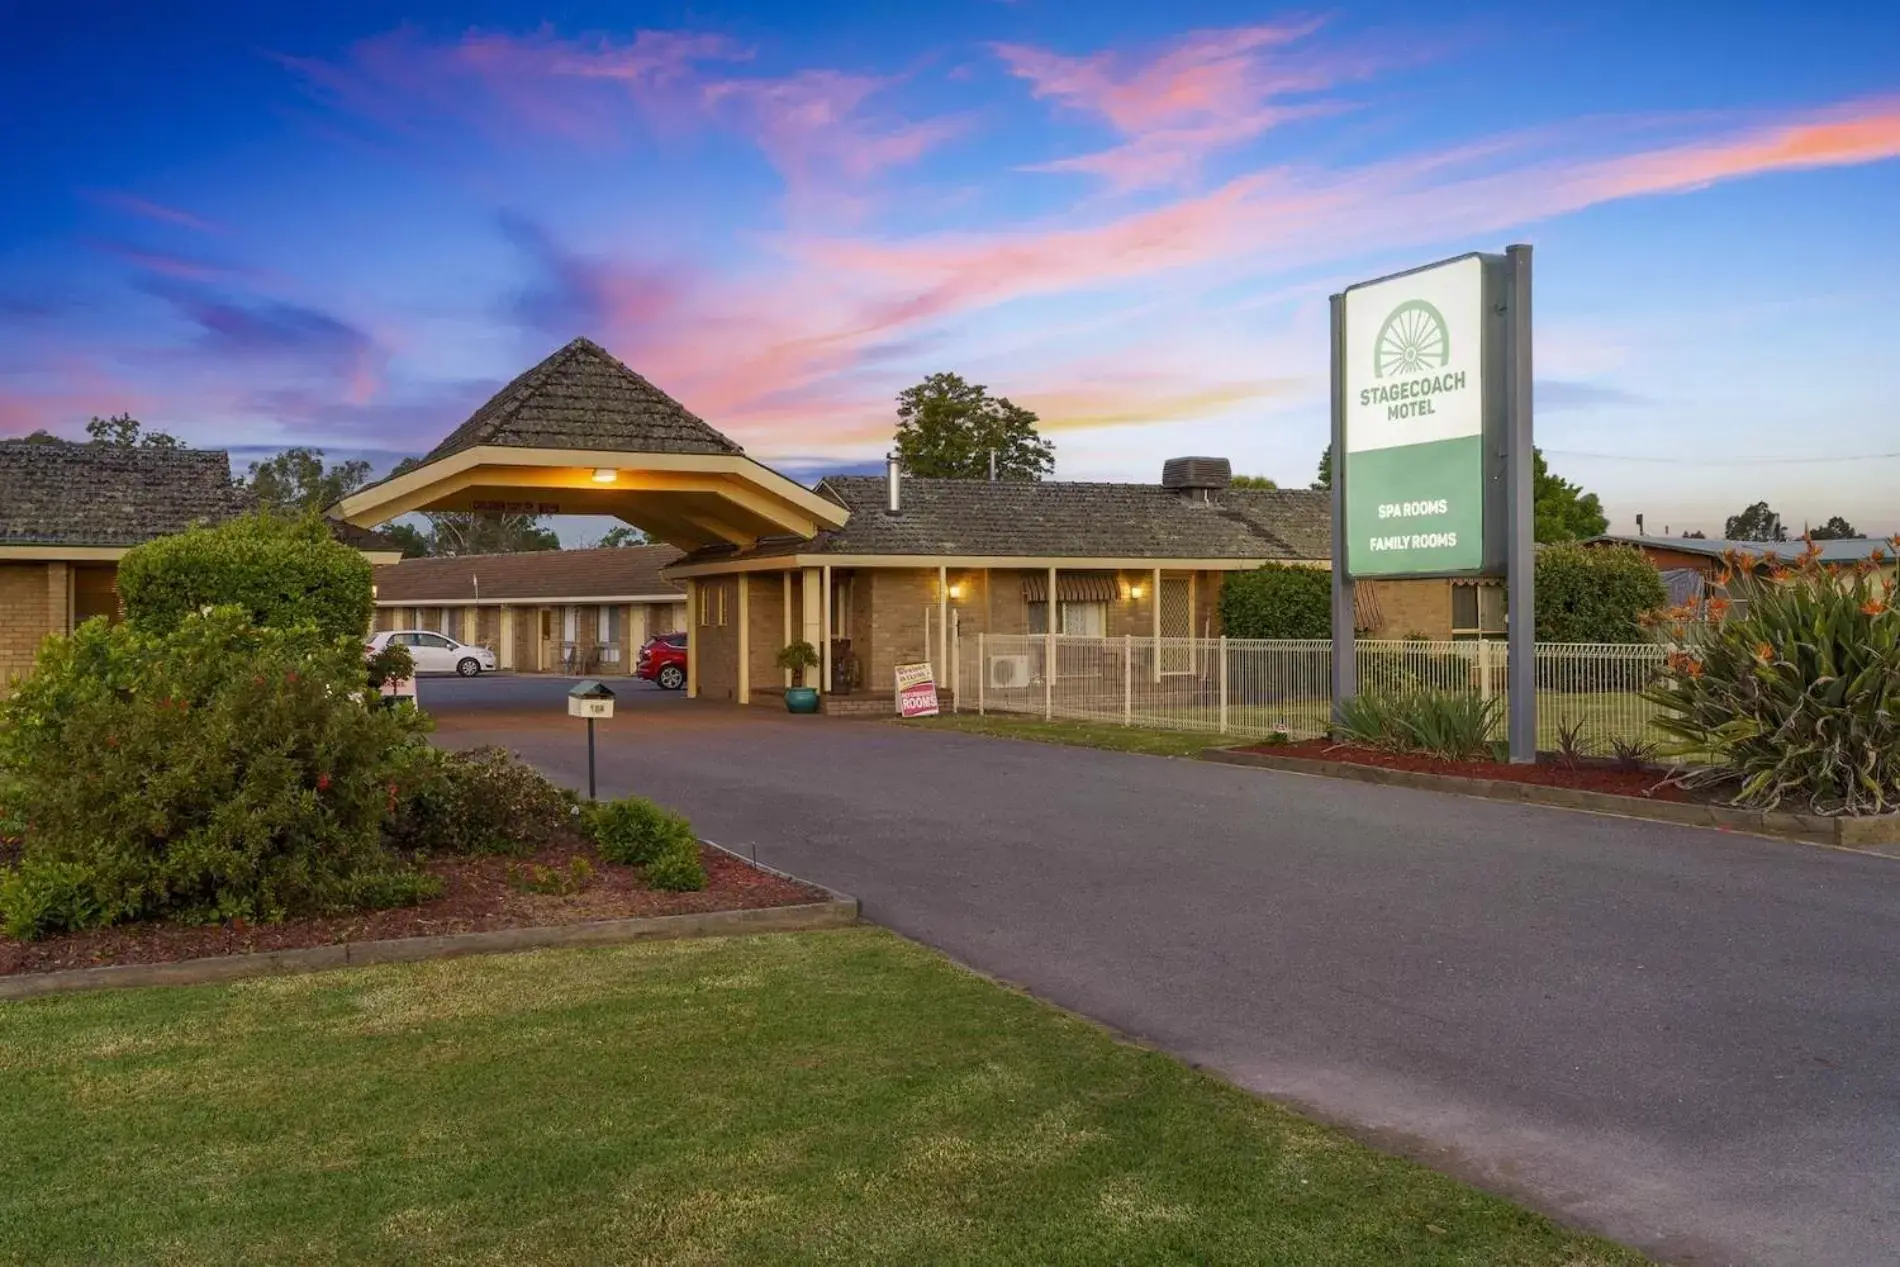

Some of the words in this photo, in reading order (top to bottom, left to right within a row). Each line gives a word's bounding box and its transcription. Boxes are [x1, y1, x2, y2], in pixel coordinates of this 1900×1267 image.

[1360, 371, 1466, 406] STAGECOACH
[1387, 398, 1435, 421] MOTEL
[1378, 503, 1403, 519] SPA
[1404, 499, 1448, 517] ROOMS
[1370, 535, 1411, 551] FAMILY
[1412, 532, 1457, 549] ROOMS
[902, 697, 937, 709] ROOMS
